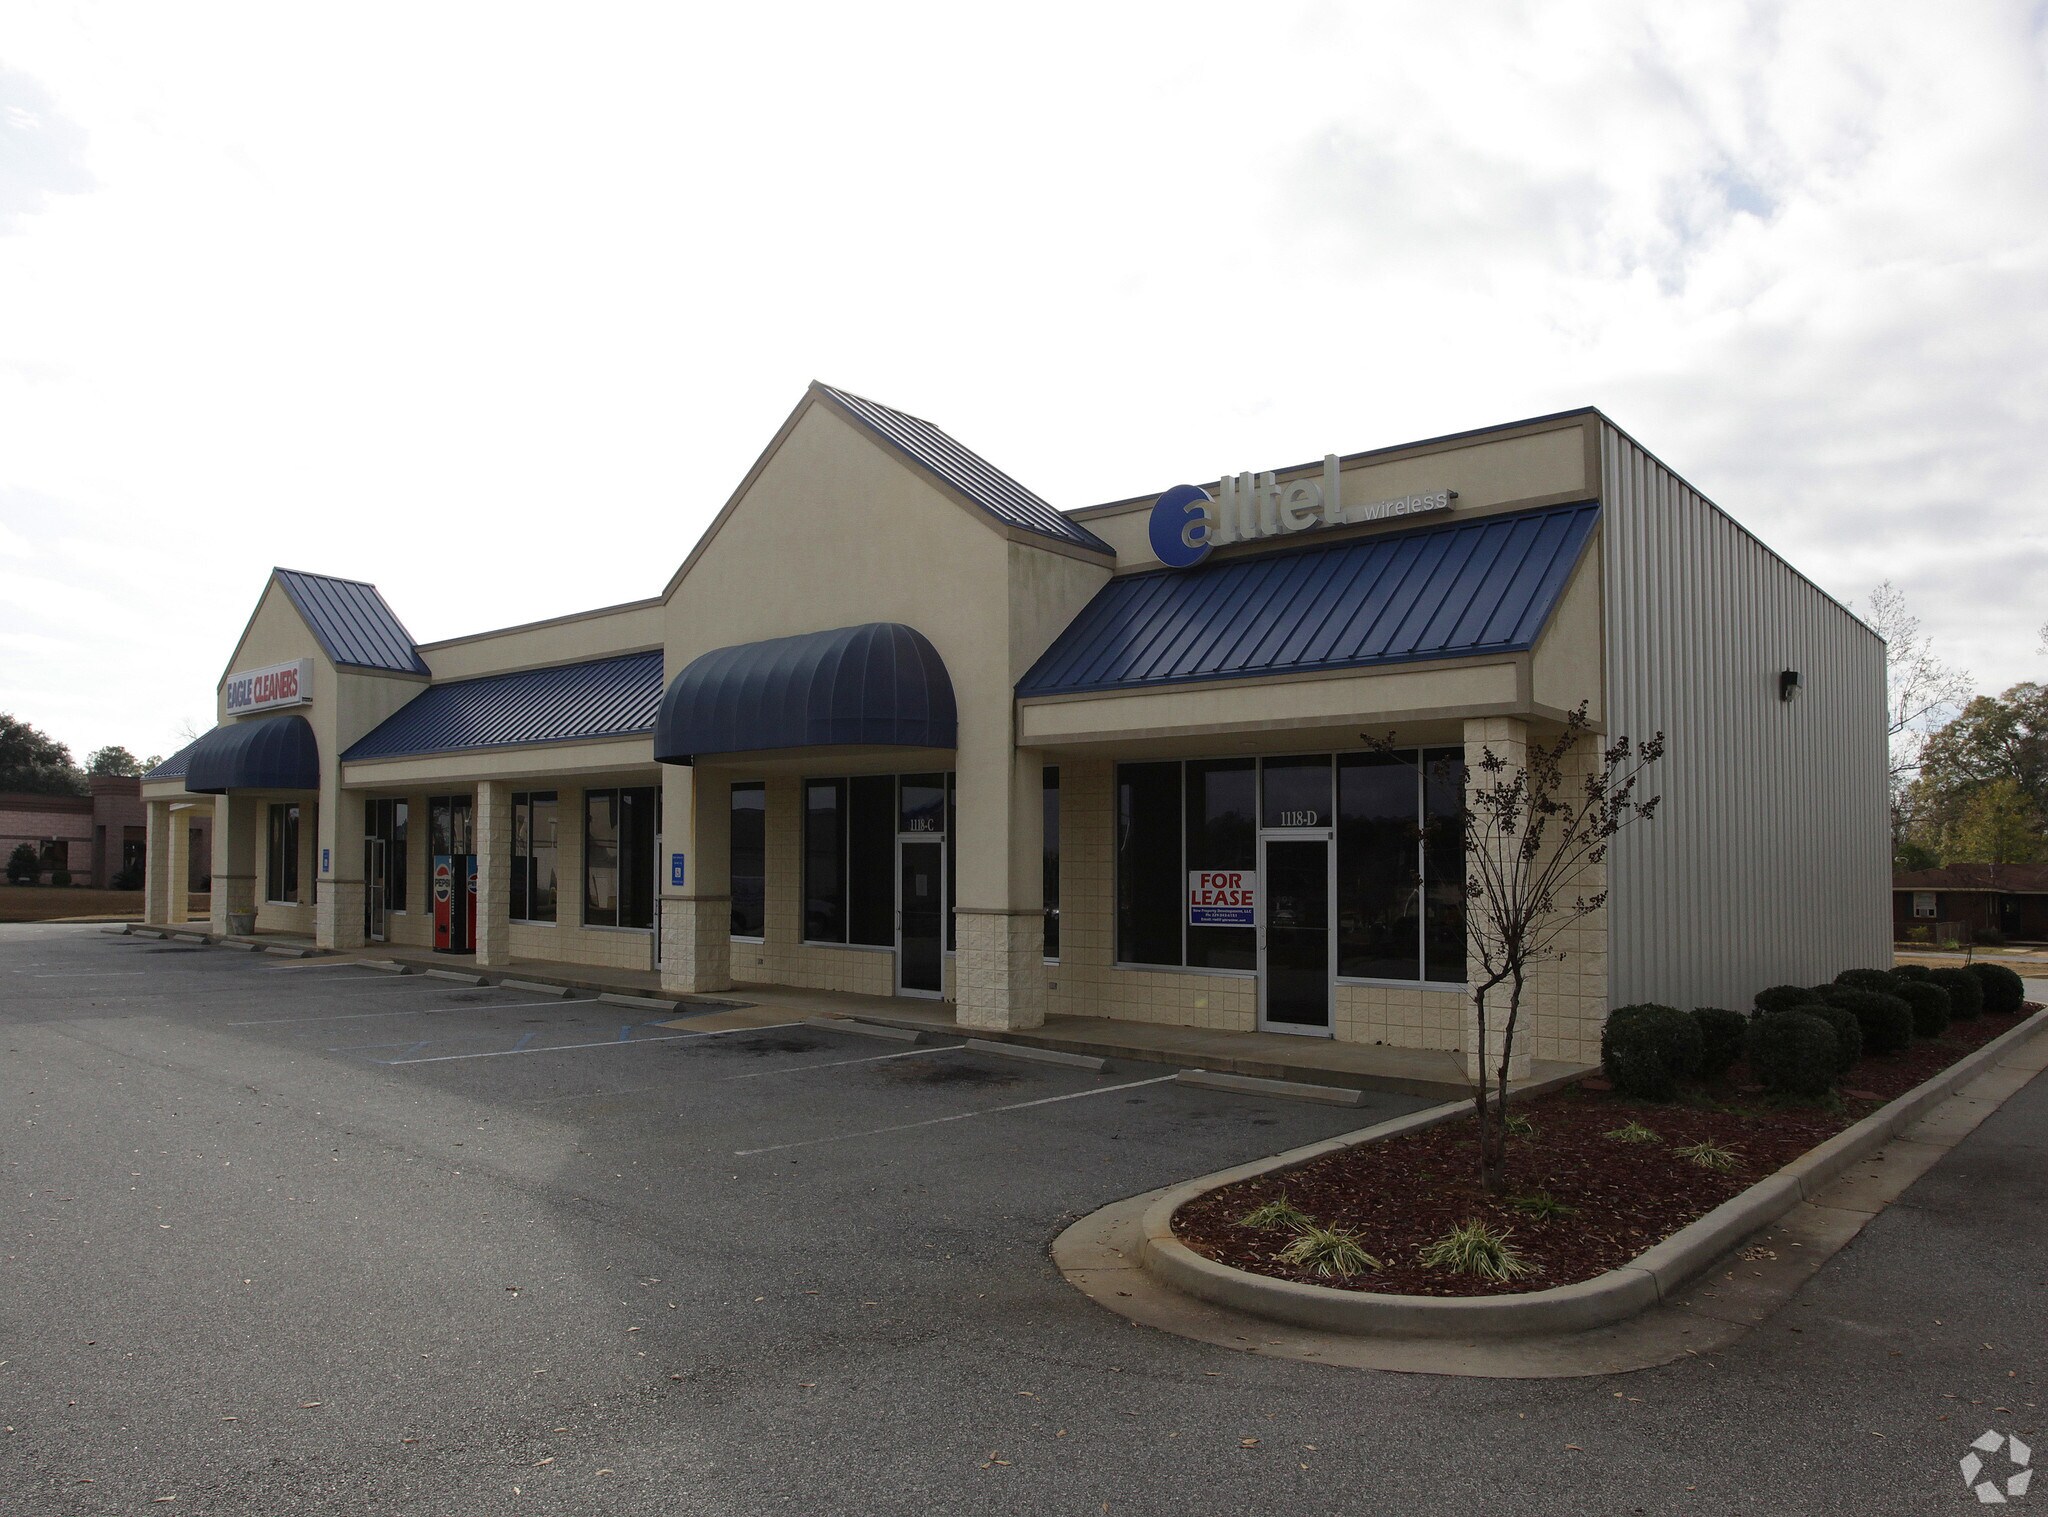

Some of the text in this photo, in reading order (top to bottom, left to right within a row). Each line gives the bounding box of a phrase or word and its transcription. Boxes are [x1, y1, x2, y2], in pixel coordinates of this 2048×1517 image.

[1181, 454, 1448, 547] alltel wireless
[227, 668, 298, 709] EAGLE CLEANERS
[910, 818, 934, 831] 1118-C
[1280, 810, 1318, 827] 1118-D
[1200, 873, 1242, 889] FOR
[1191, 890, 1254, 906] LEASE
